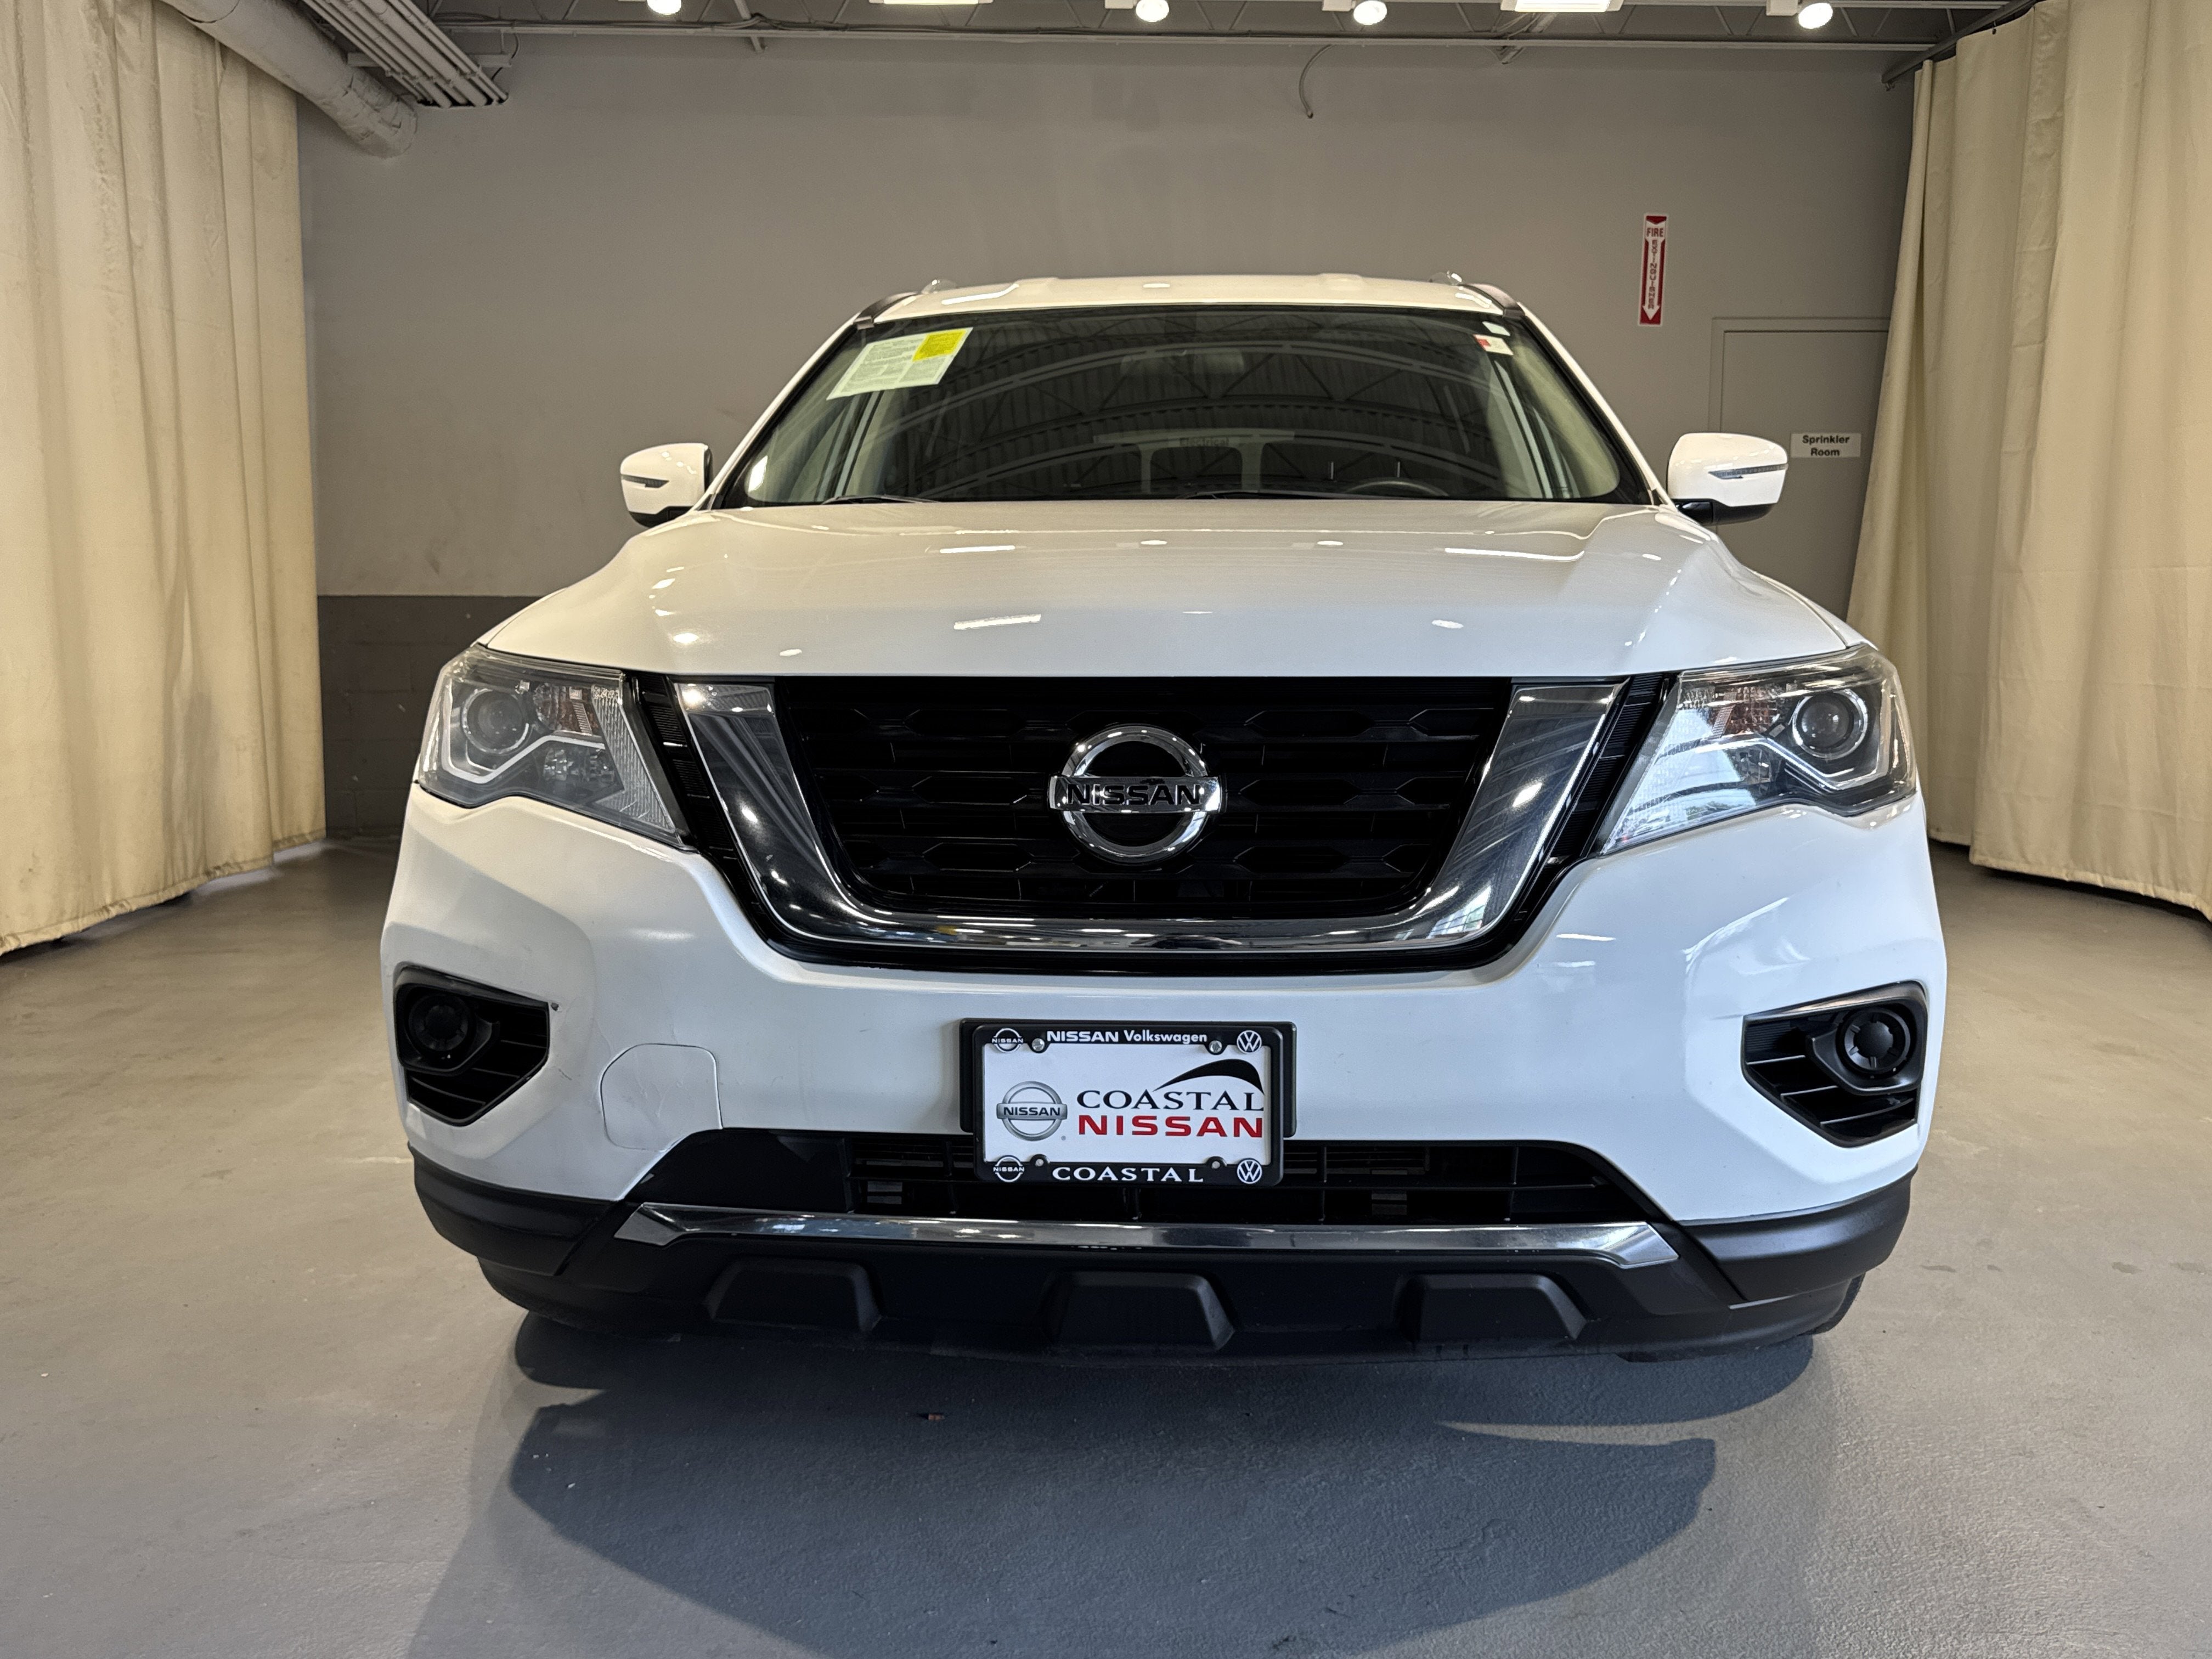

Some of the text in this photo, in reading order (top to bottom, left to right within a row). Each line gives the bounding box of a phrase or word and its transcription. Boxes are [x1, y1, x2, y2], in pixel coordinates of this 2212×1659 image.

[1646, 228, 1664, 237] FIRE
[1647, 240, 1658, 309] EXTINGUISHER
[1802, 435, 1850, 445] Sprinkler
[1810, 448, 1840, 456] Room
[1066, 784, 1201, 805] NISSAN
[1047, 1030, 1207, 1045] NISSAN Volkswagen
[1077, 1089, 1264, 1111] COASTAL
[1003, 1107, 1060, 1116] NISSAN
[1079, 1115, 1262, 1138] NISSAN
[1053, 1166, 1204, 1182] COASTAL
